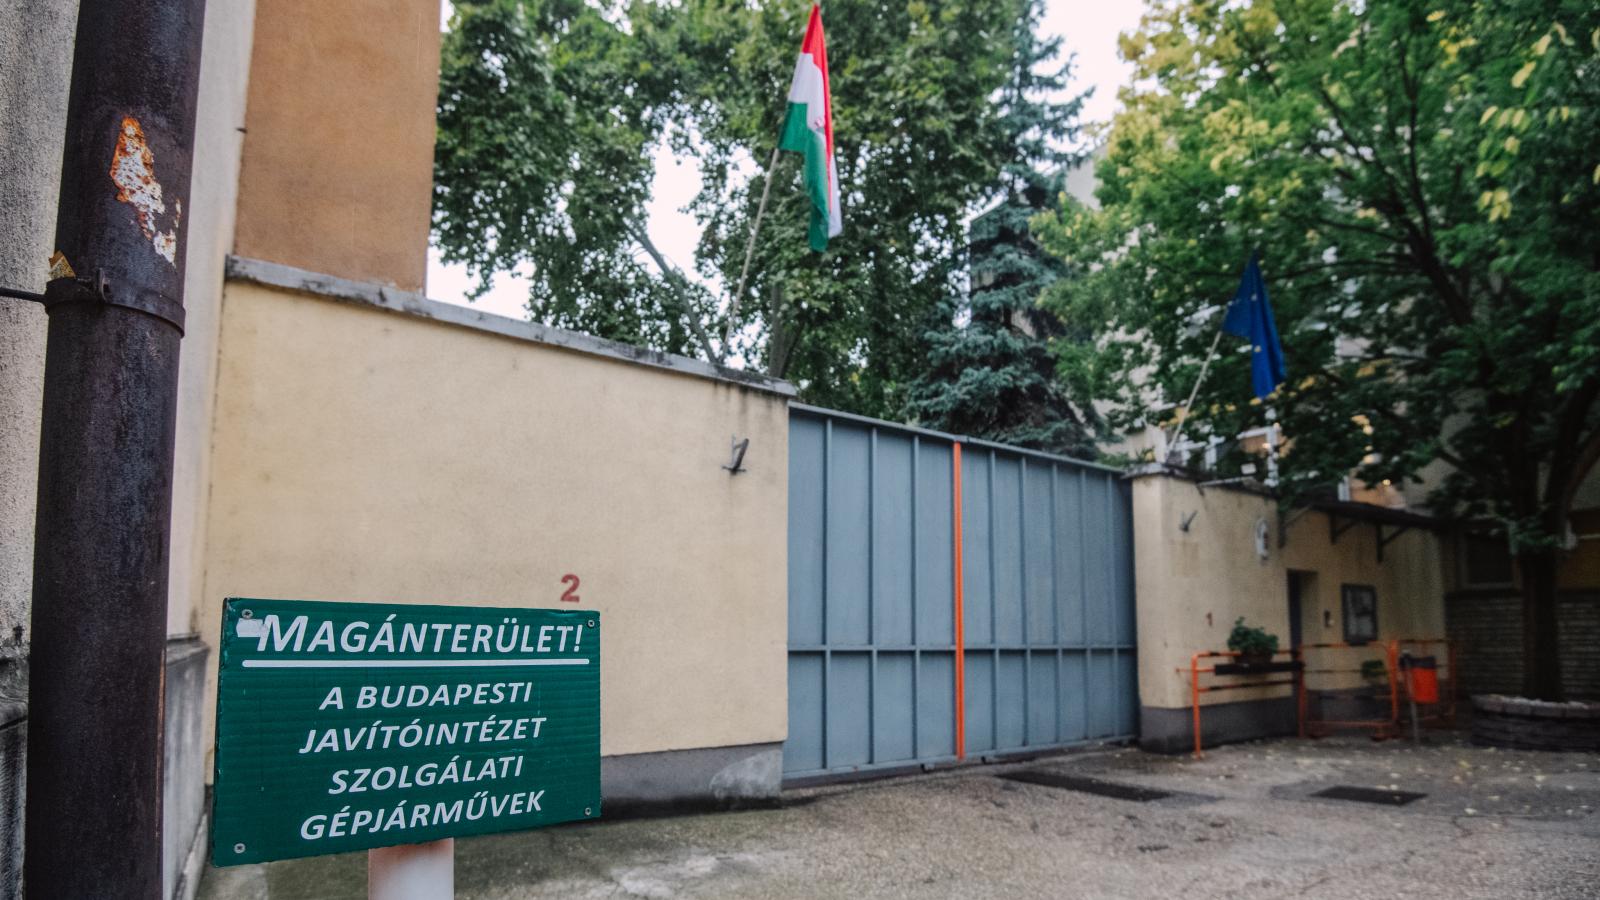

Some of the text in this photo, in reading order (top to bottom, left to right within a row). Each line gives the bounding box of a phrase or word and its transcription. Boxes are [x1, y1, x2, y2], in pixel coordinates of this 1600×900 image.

[560, 574, 580, 602] 2
[256, 614, 583, 653] MAGÁNTERÜLET!
[319, 682, 533, 710] A BUDAPESTI
[299, 715, 547, 754] JAVÍTÓINTÉZET
[328, 755, 524, 795] SZOLGÁLATI
[300, 790, 545, 840] GÉPJÁRMŰVEK
